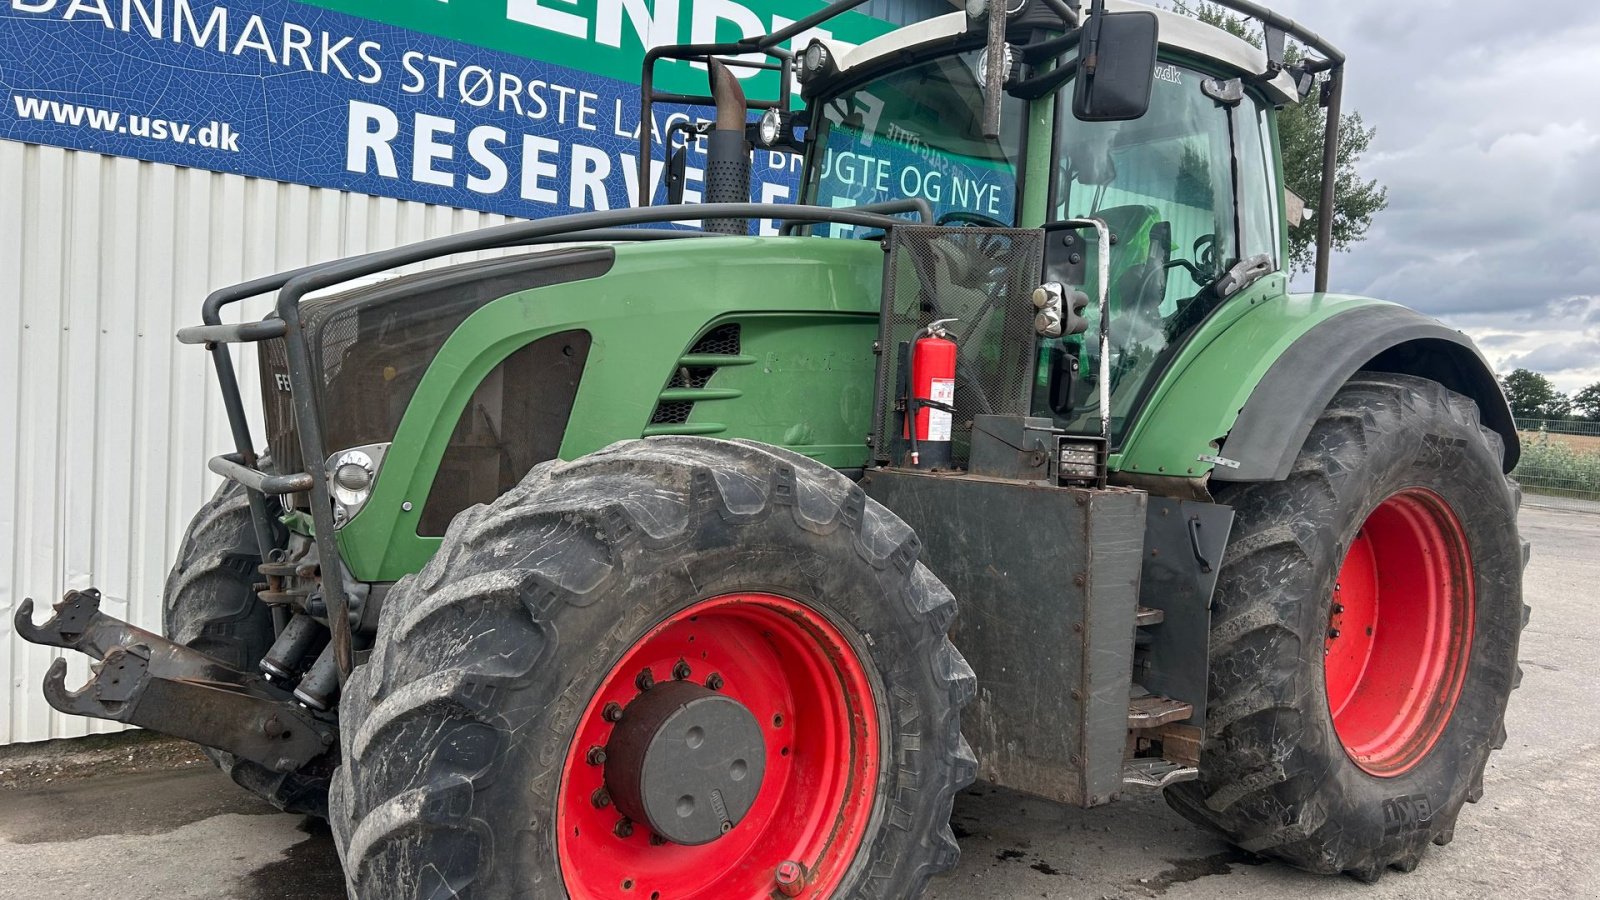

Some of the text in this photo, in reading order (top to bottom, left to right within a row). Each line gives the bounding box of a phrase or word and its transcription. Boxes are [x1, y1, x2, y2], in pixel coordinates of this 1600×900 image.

[12, 0, 383, 84] ANMARKS
[401, 50, 598, 131] STØRSTE
[900, 165, 942, 202] OG
[951, 176, 1002, 215] NYE
[14, 95, 240, 152] www.usv.dk
